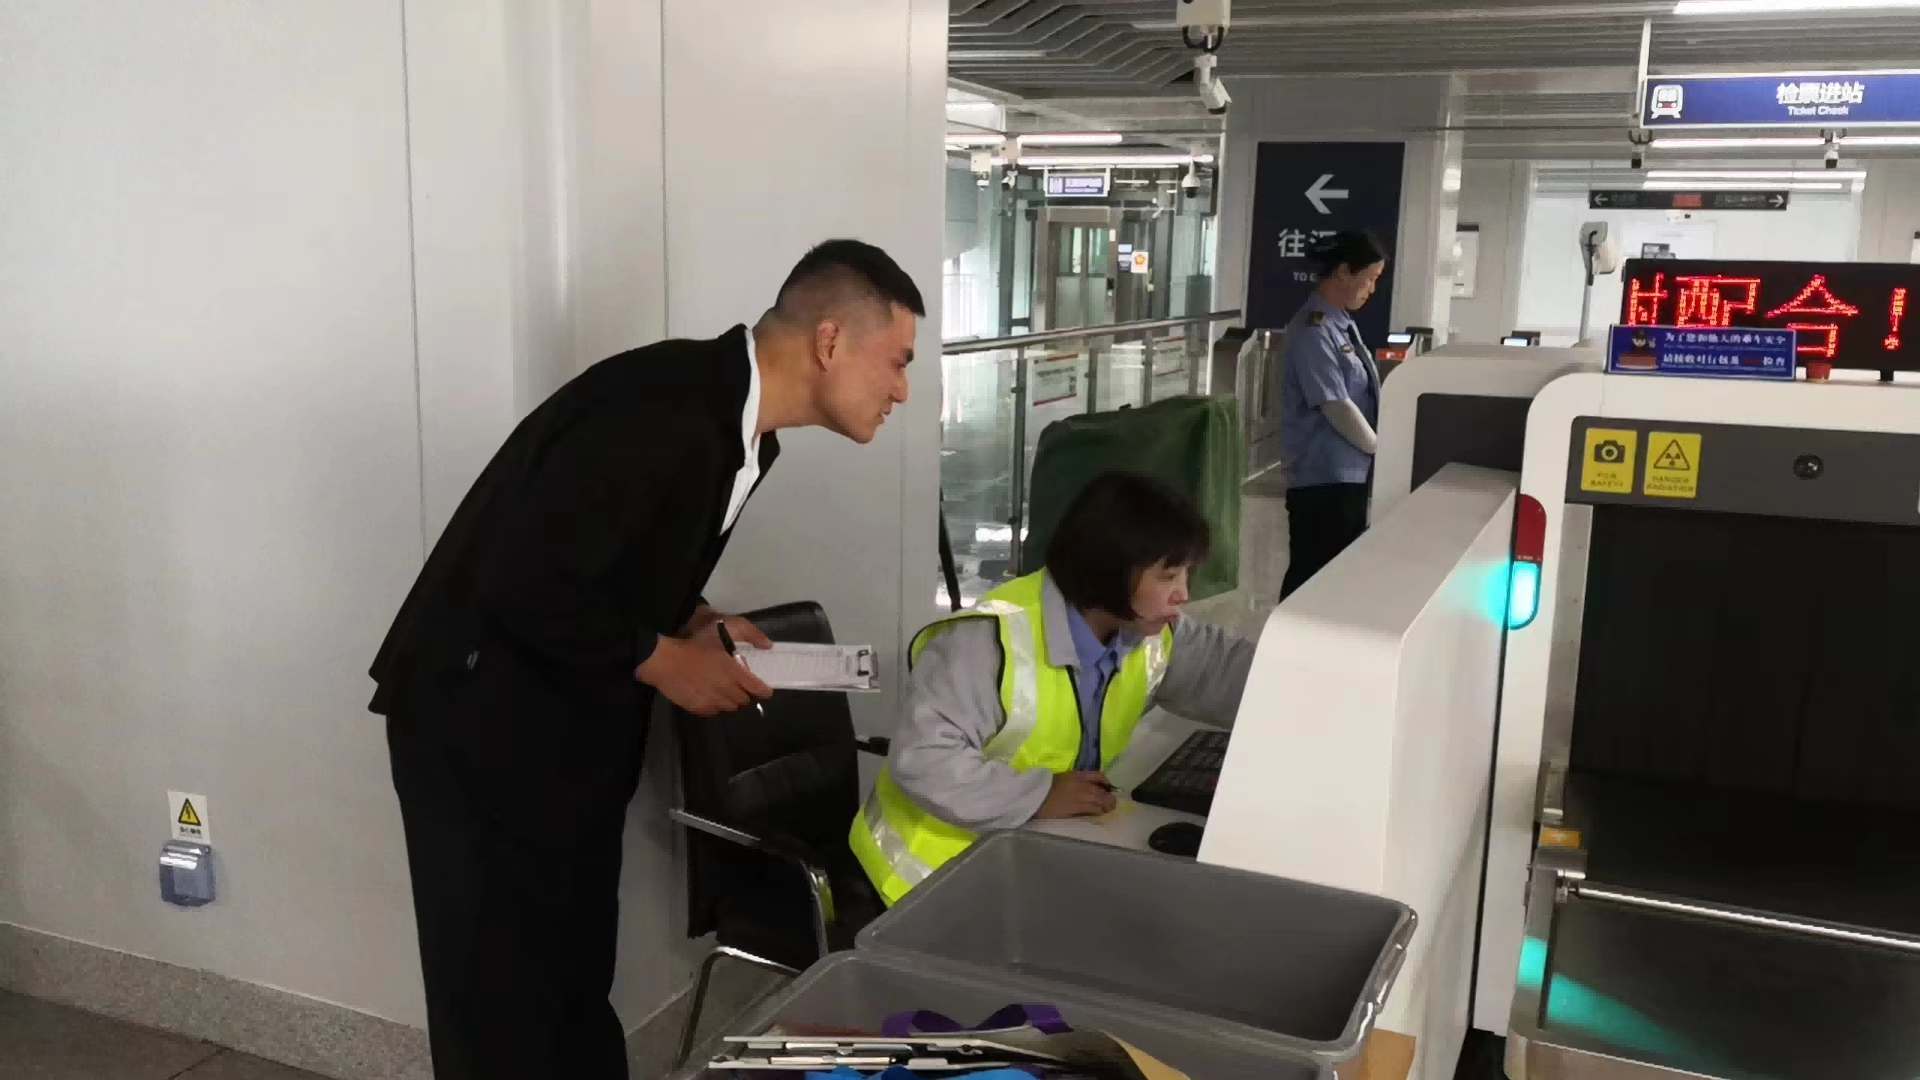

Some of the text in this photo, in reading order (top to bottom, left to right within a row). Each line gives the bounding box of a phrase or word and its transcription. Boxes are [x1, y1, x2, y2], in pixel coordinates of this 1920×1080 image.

[1776, 81, 1865, 104] 检票进站
[1787, 106, 1849, 115] Ticket Check
